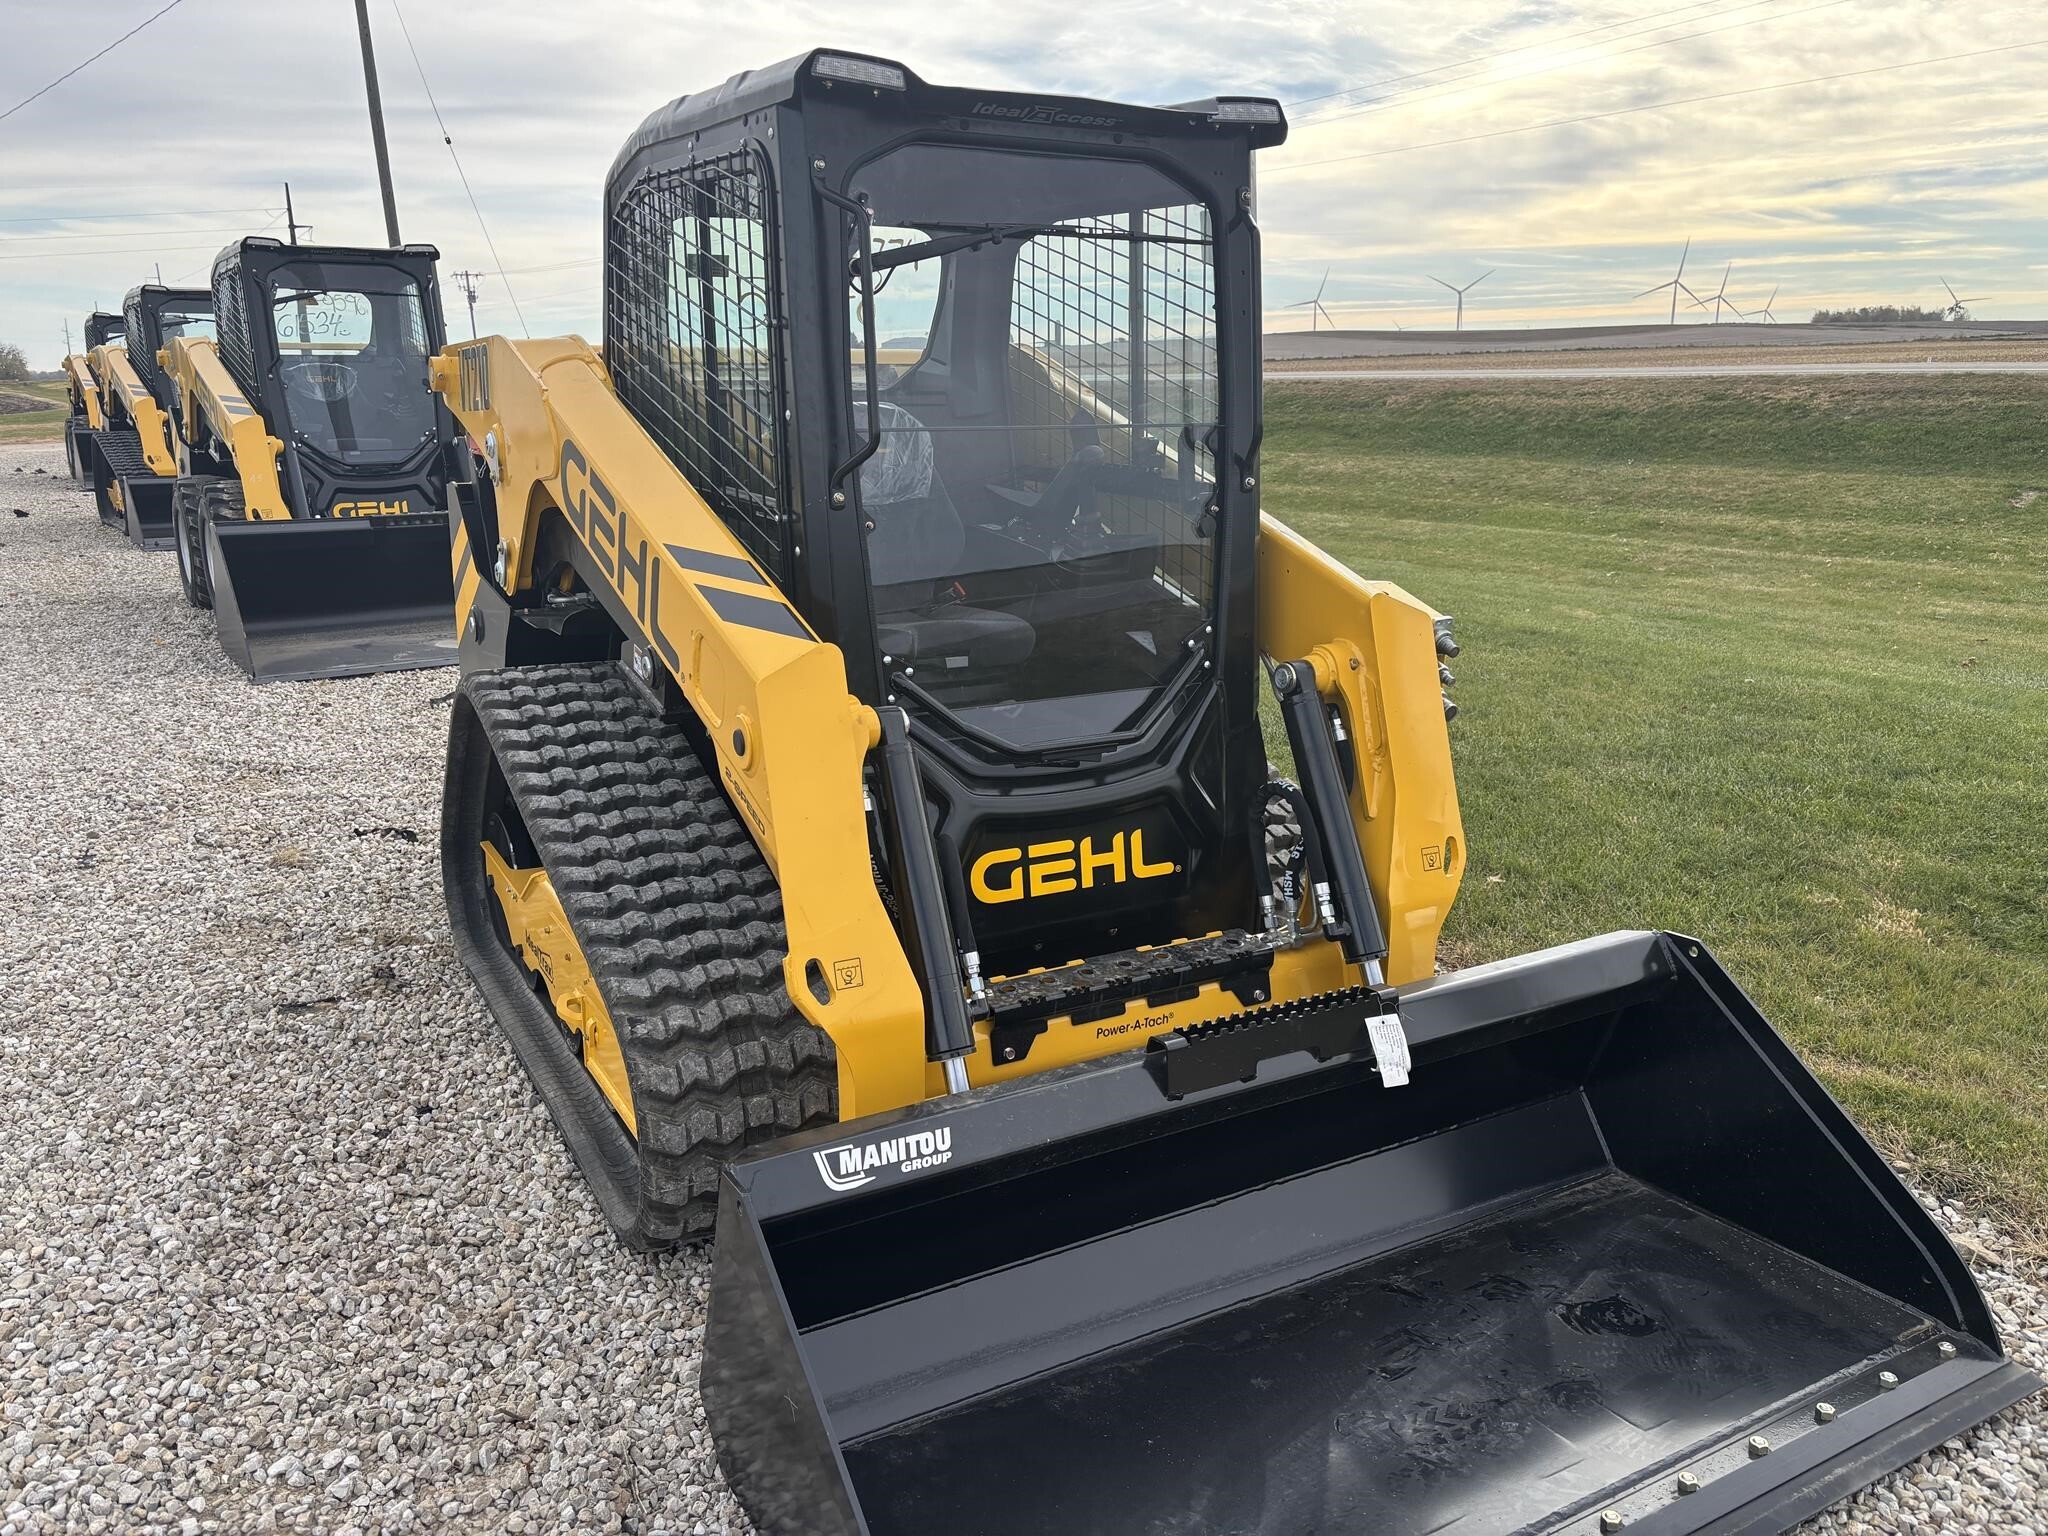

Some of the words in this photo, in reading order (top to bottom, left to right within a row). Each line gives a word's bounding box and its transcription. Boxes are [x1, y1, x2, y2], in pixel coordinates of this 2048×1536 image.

[561, 439, 680, 674] GEHL
[970, 828, 1175, 904] GEHL
[839, 1126, 952, 1175] MANITOU
[900, 1151, 953, 1173] GROUP
